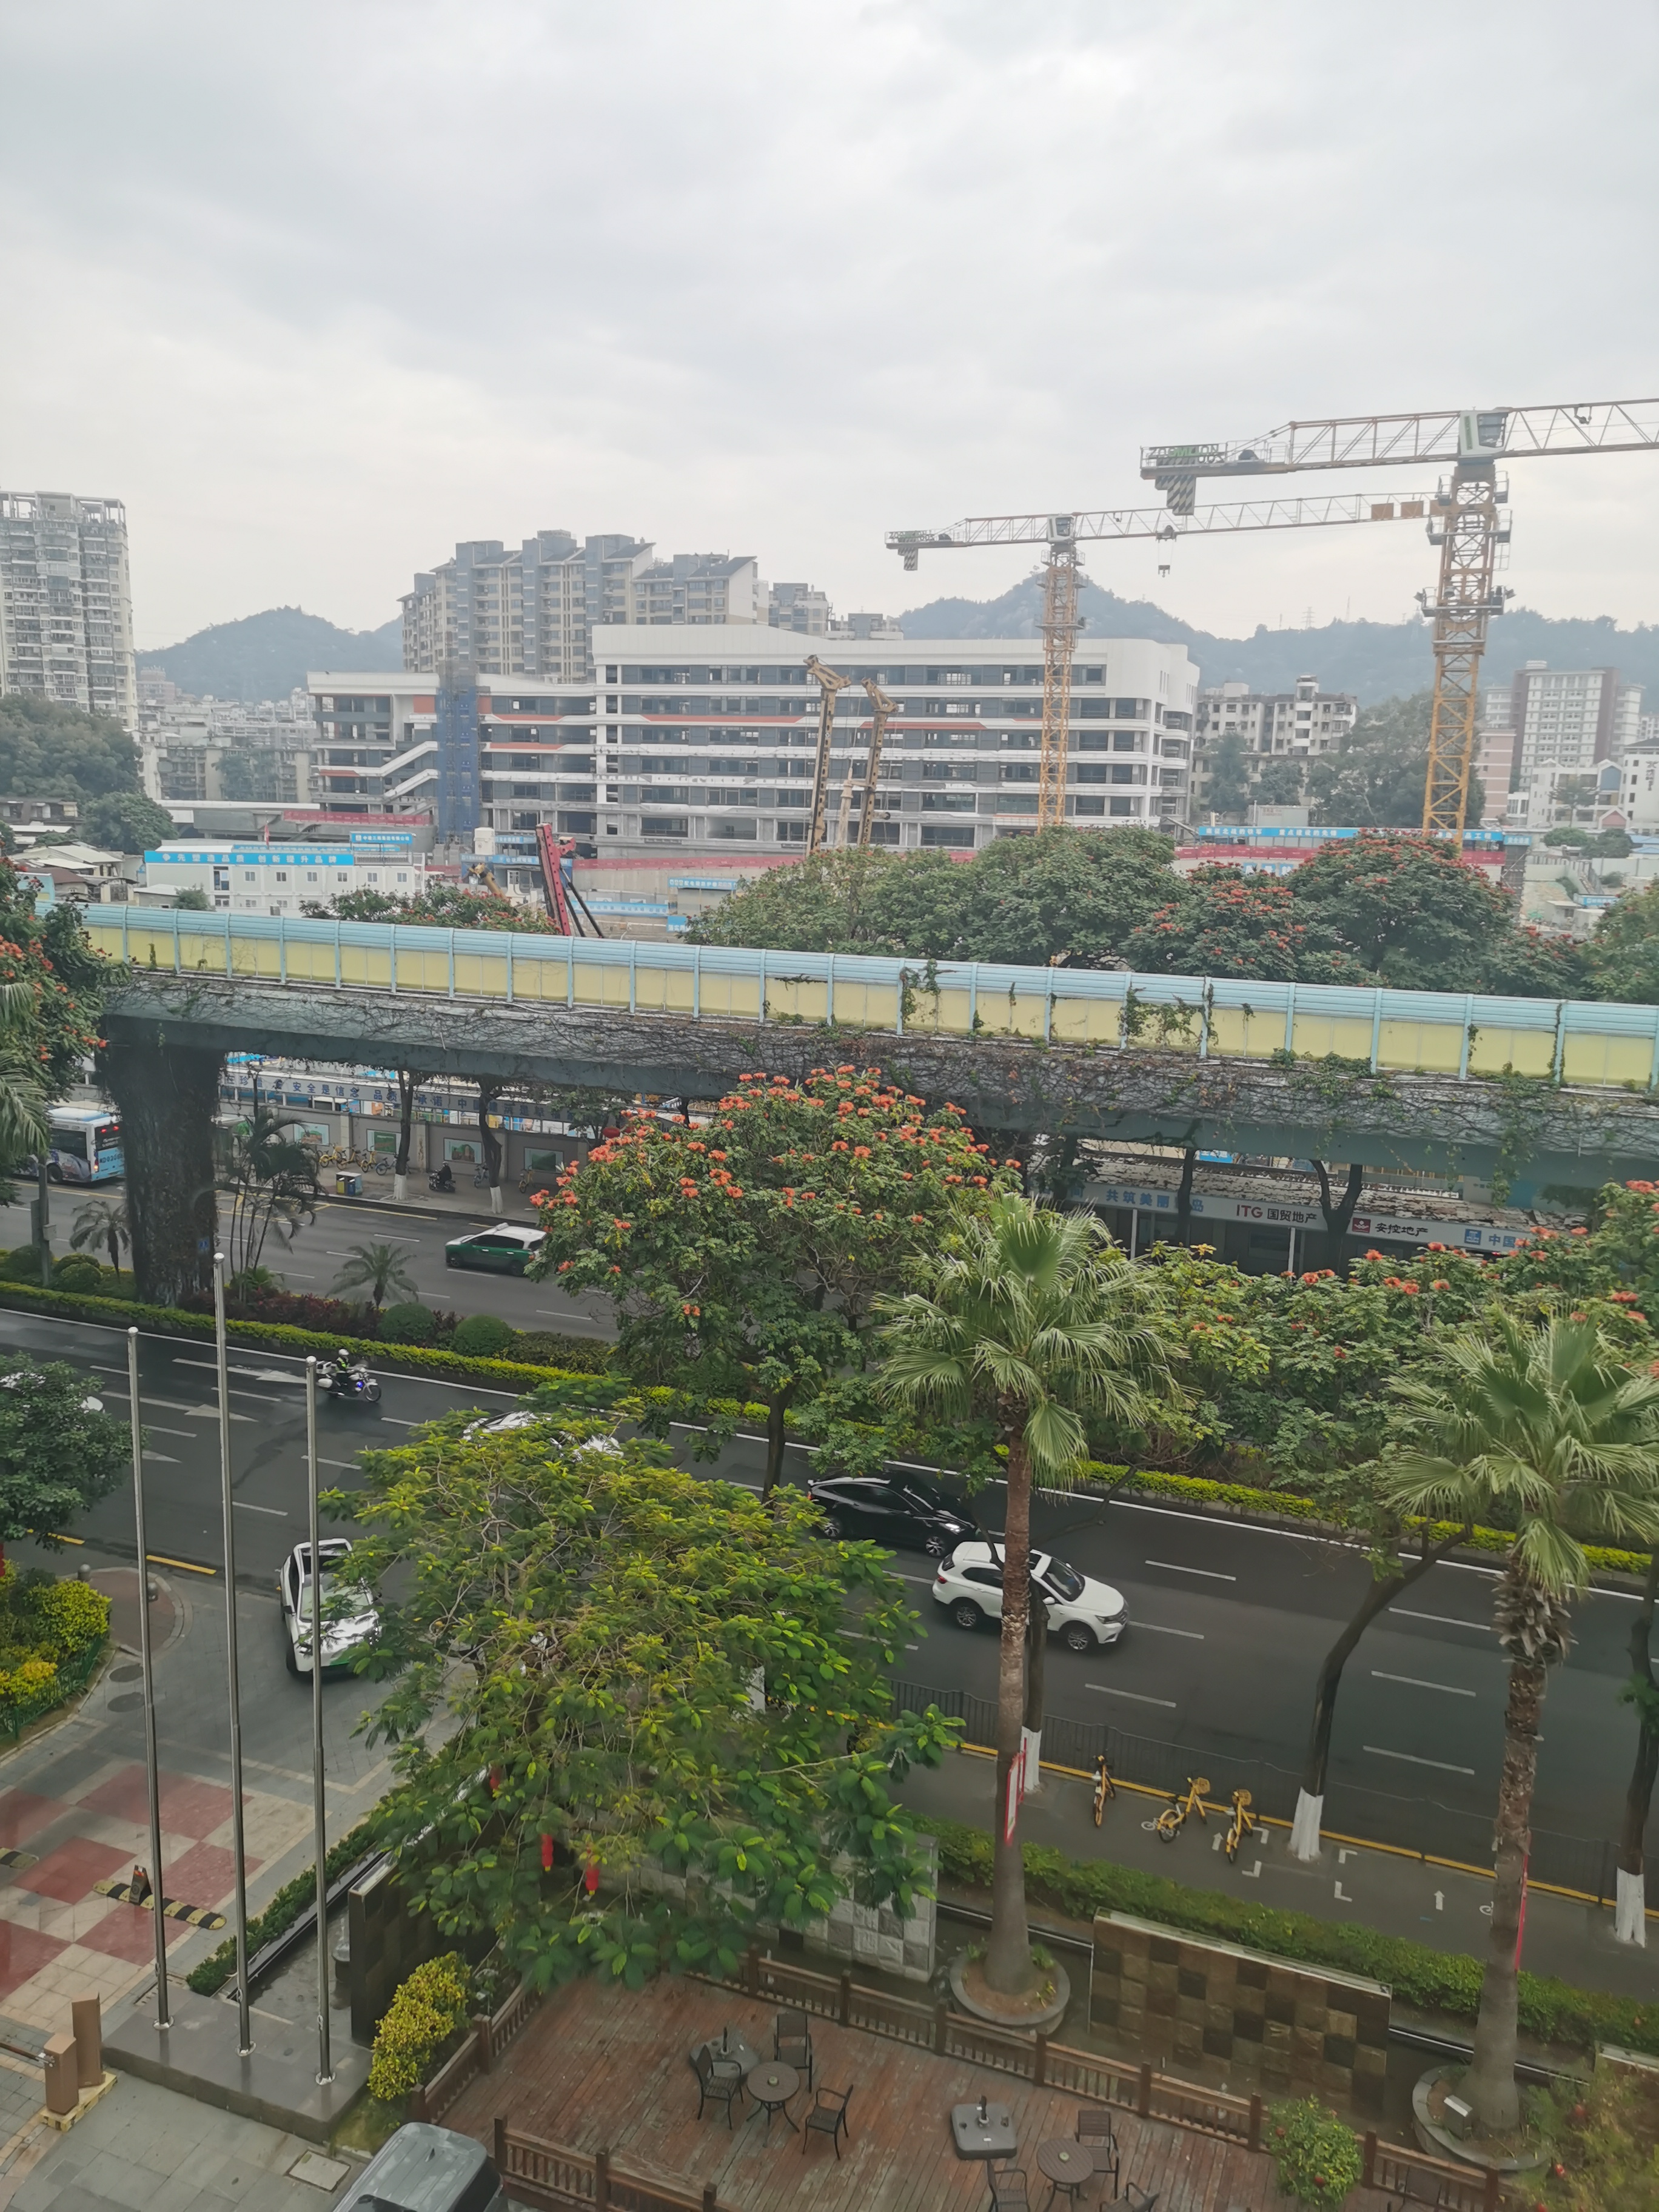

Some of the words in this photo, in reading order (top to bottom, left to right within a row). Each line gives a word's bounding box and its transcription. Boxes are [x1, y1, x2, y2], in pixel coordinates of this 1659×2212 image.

[1106, 1188, 1204, 1212] 共筑美丽岛
[1236, 1204, 1263, 1218] ITG
[1267, 1208, 1317, 1224] 国贸地产
